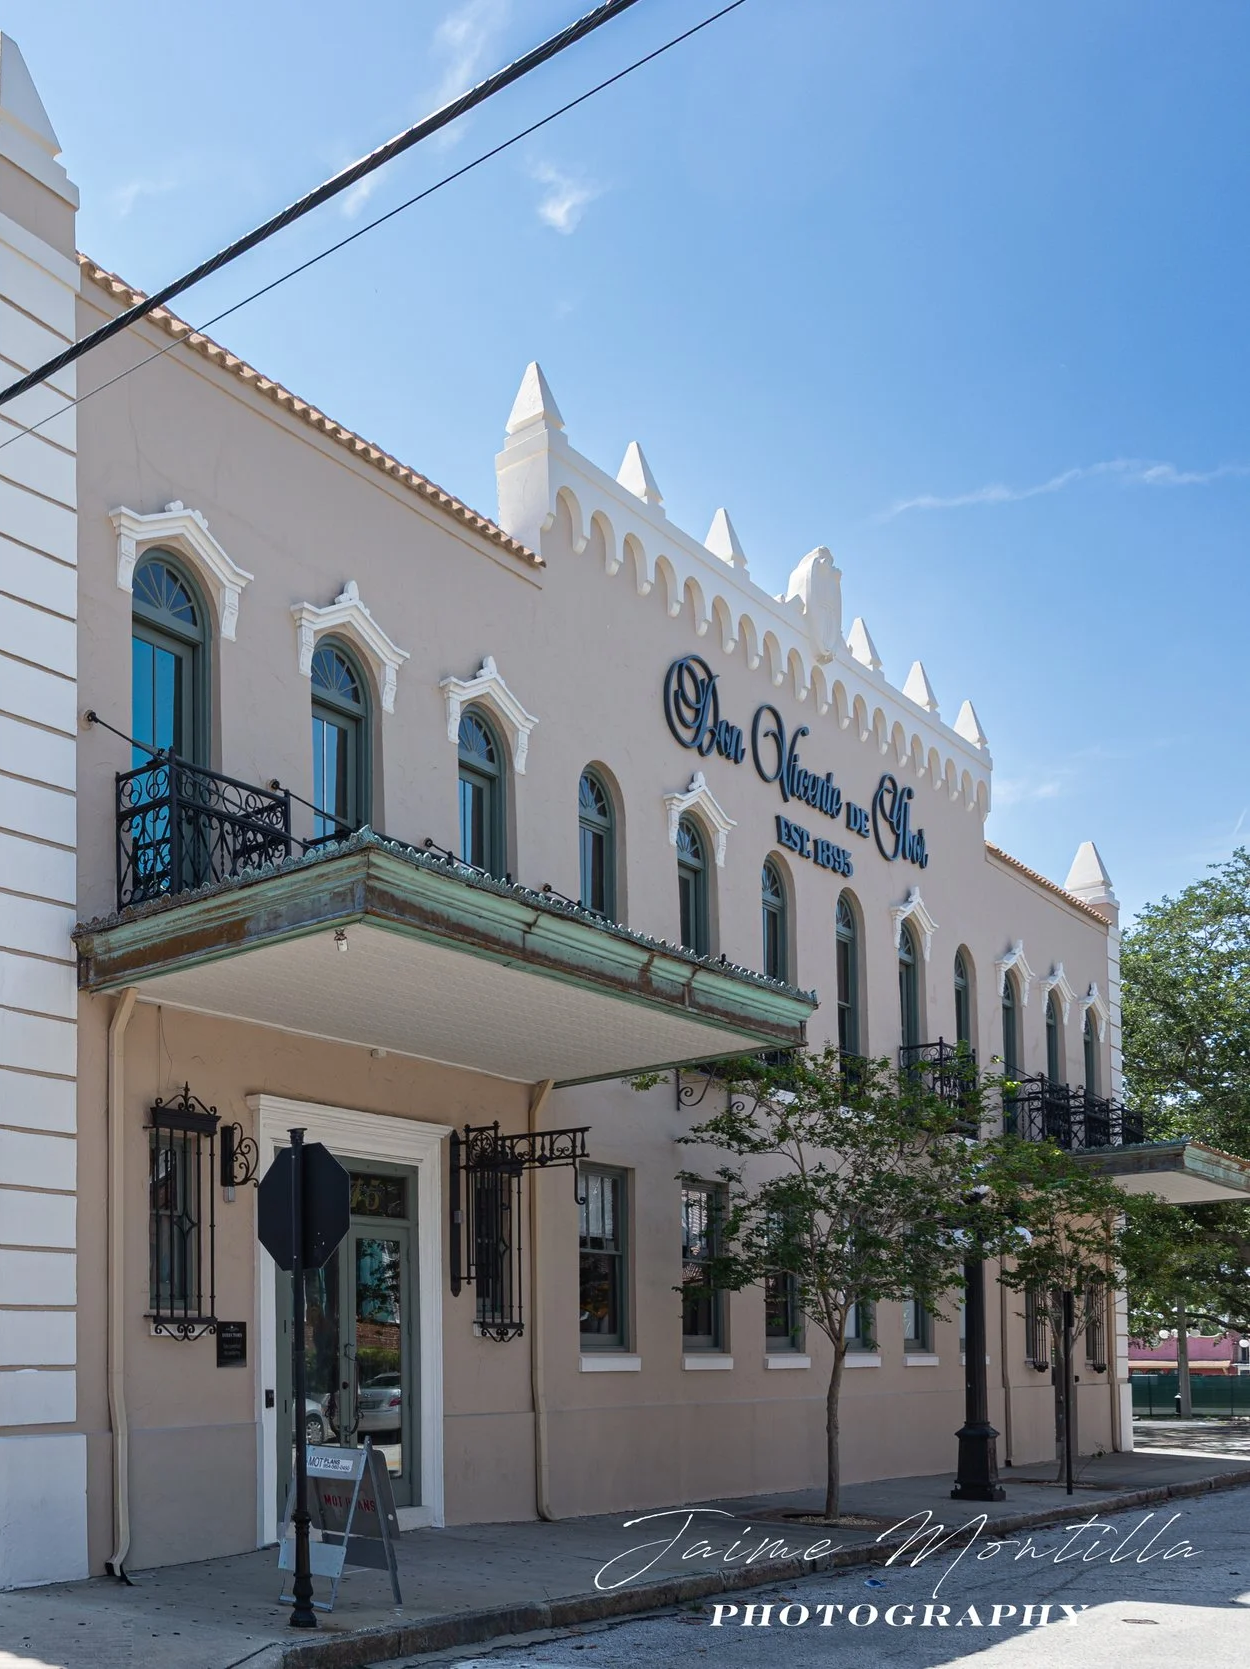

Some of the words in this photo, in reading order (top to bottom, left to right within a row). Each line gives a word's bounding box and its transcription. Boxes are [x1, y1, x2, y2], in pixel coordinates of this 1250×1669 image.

[663, 654, 746, 764] Don
[751, 704, 843, 819] Vicente
[846, 801, 870, 838] DE
[872, 772, 928, 869] Ybor
[775, 815, 812, 859] EST.
[813, 838, 854, 878] 1895
[308, 1456, 324, 1468] MOT
[323, 1457, 341, 1465] PLANS
[324, 1494, 343, 1507] MOT
[345, 1496, 376, 1512] PANS
